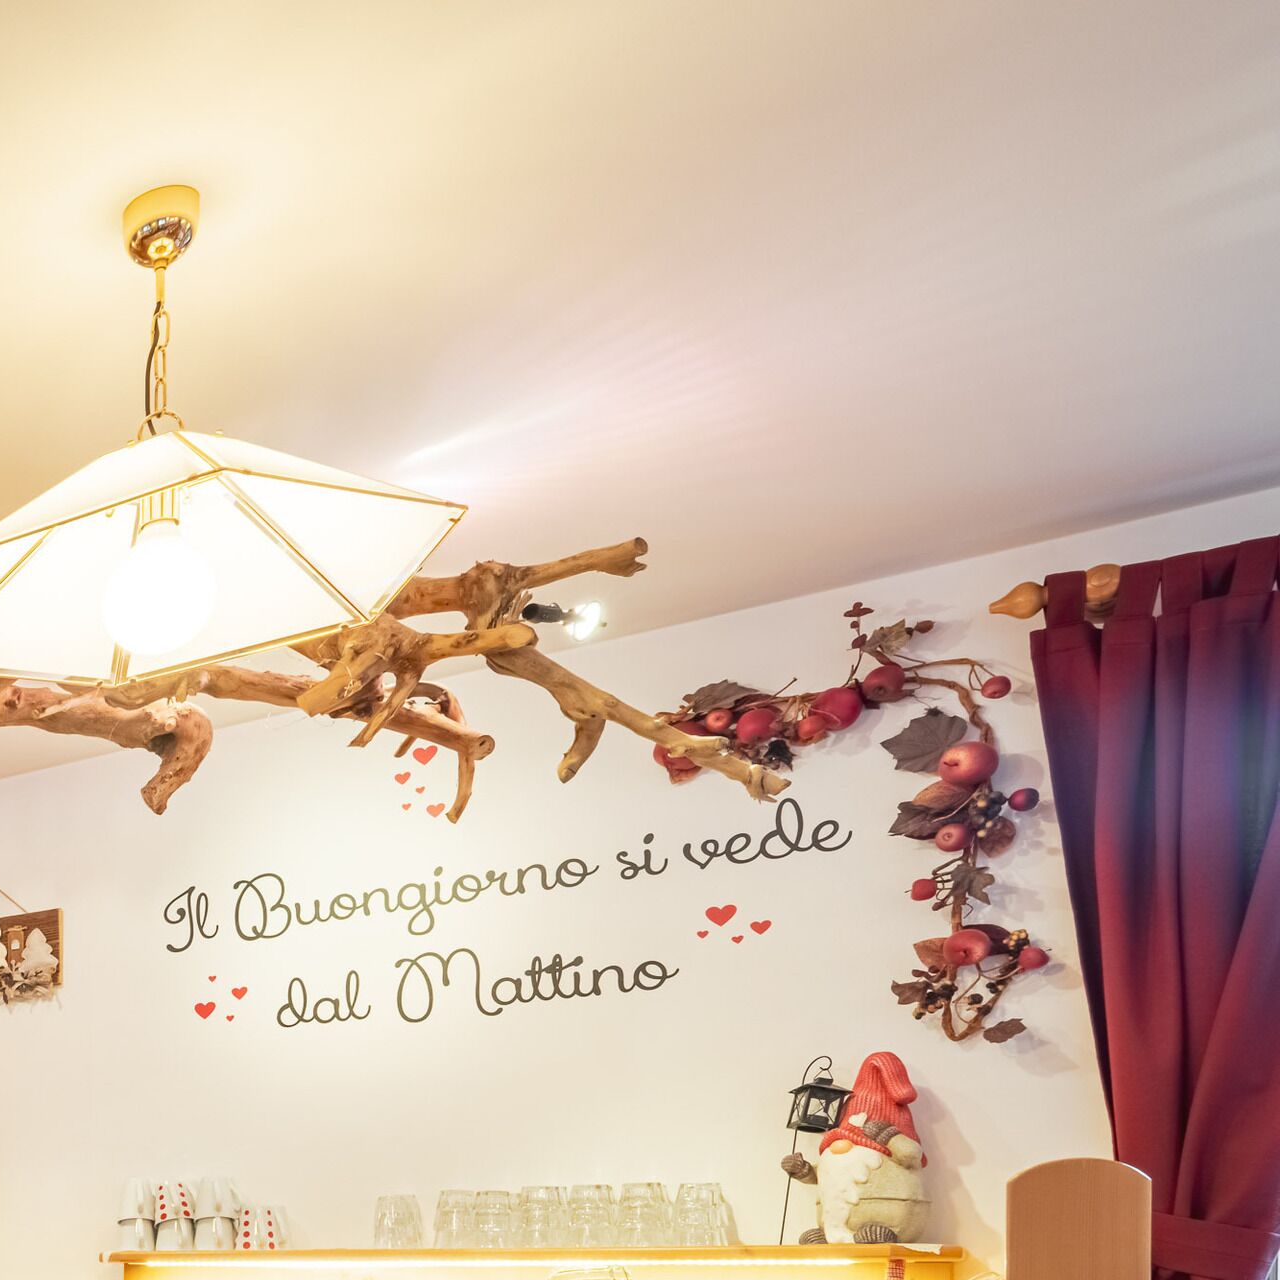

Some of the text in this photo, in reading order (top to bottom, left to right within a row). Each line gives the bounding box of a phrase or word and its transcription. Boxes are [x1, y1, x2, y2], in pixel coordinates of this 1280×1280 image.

[162, 797, 853, 954] Il Buongiorno si vede
[276, 947, 680, 1029] dal Mattino
